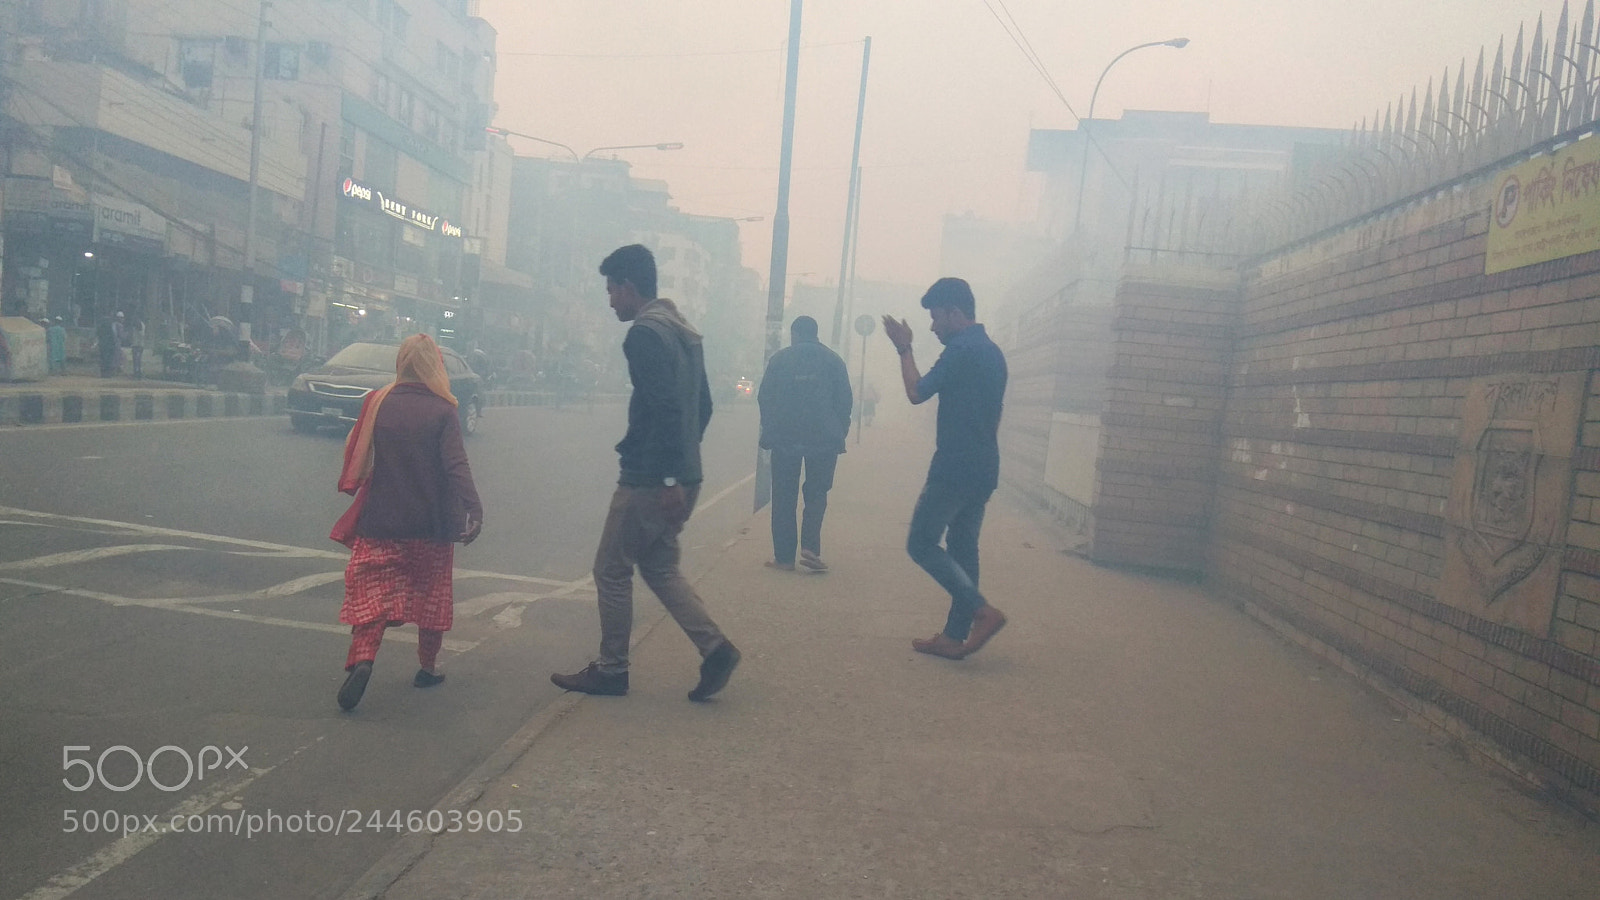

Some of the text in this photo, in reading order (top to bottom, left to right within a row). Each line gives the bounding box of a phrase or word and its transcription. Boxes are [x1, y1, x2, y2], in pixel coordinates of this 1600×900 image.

[350, 183, 372, 201] pepsi
[50, 200, 92, 211] aramit
[101, 206, 141, 226] aramit
